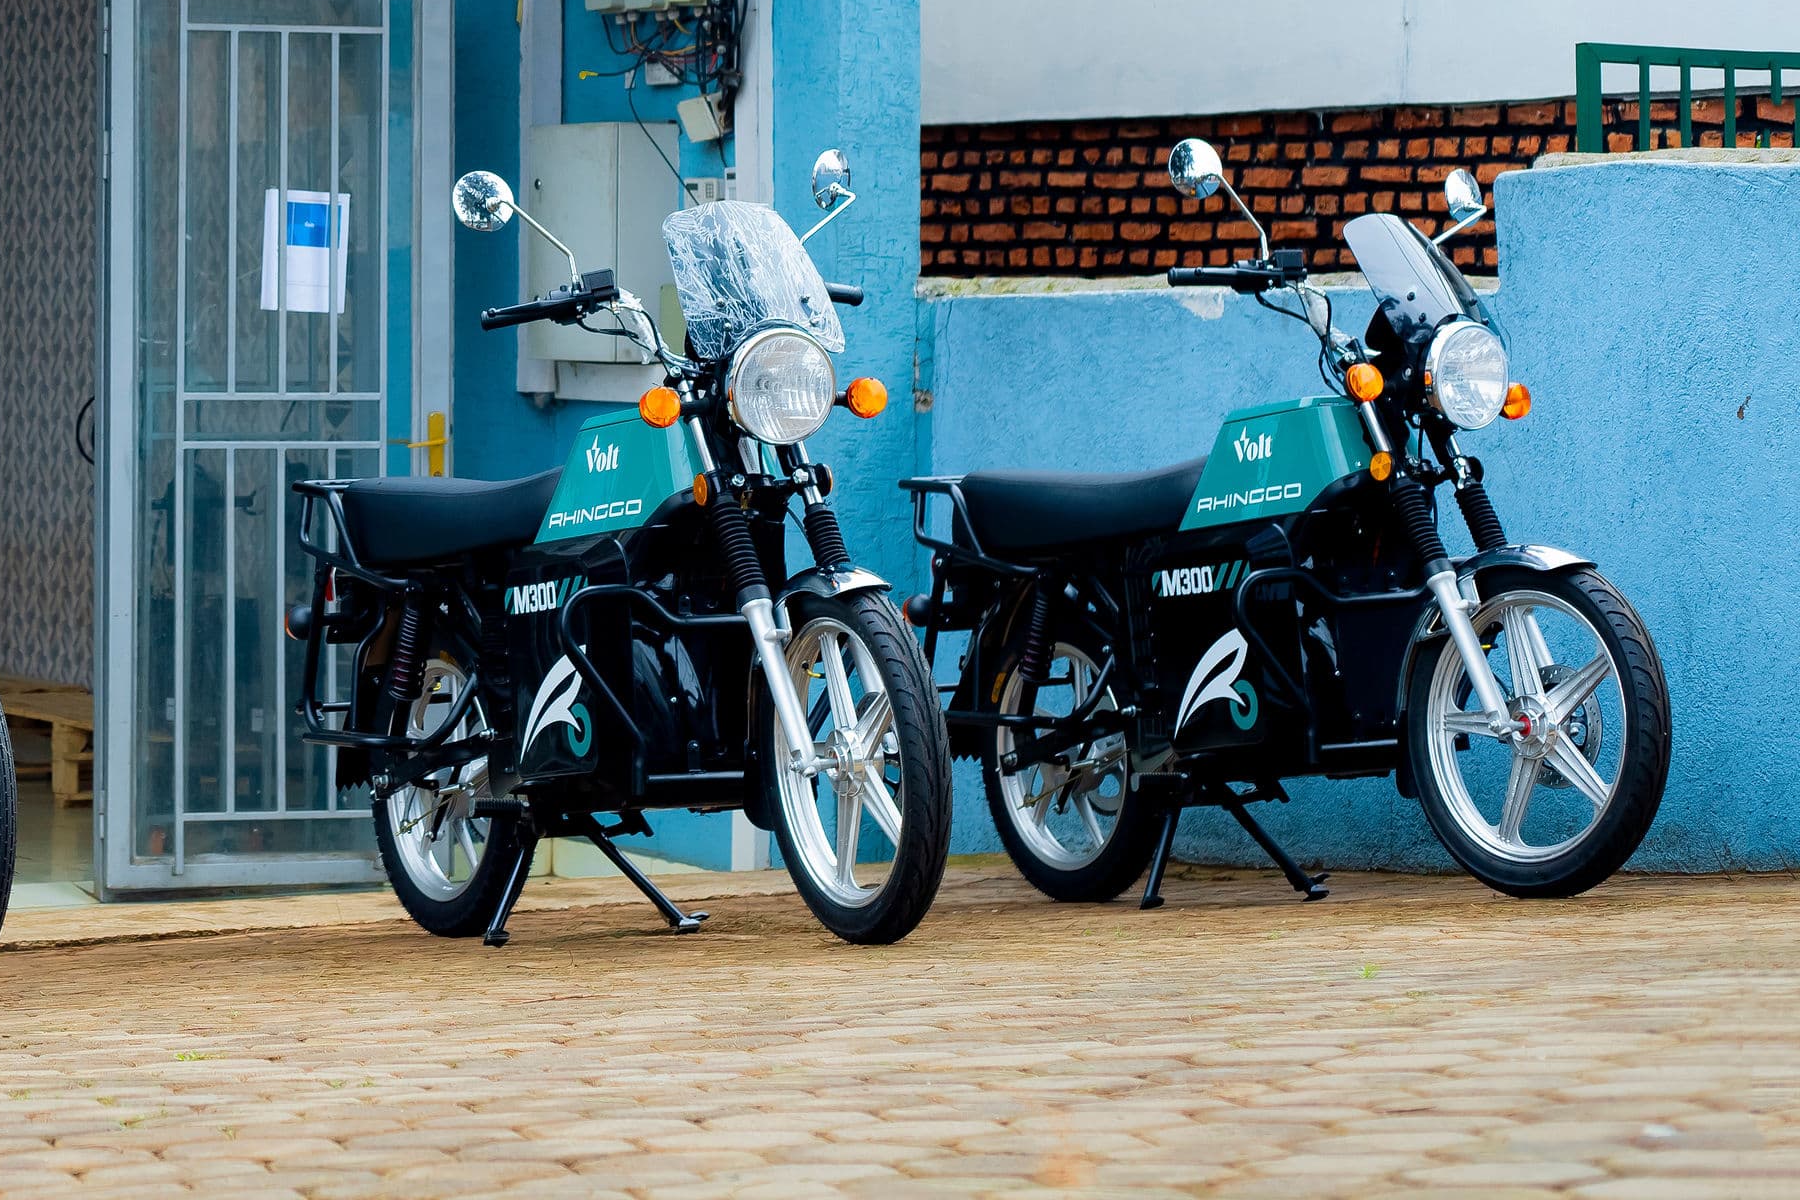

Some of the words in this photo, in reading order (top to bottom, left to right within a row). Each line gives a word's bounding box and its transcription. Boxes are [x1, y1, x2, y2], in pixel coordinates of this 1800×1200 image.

[586, 434, 619, 474] Volt
[1234, 425, 1273, 463] Volt
[513, 581, 557, 615] M300
[1161, 566, 1213, 597] M300
